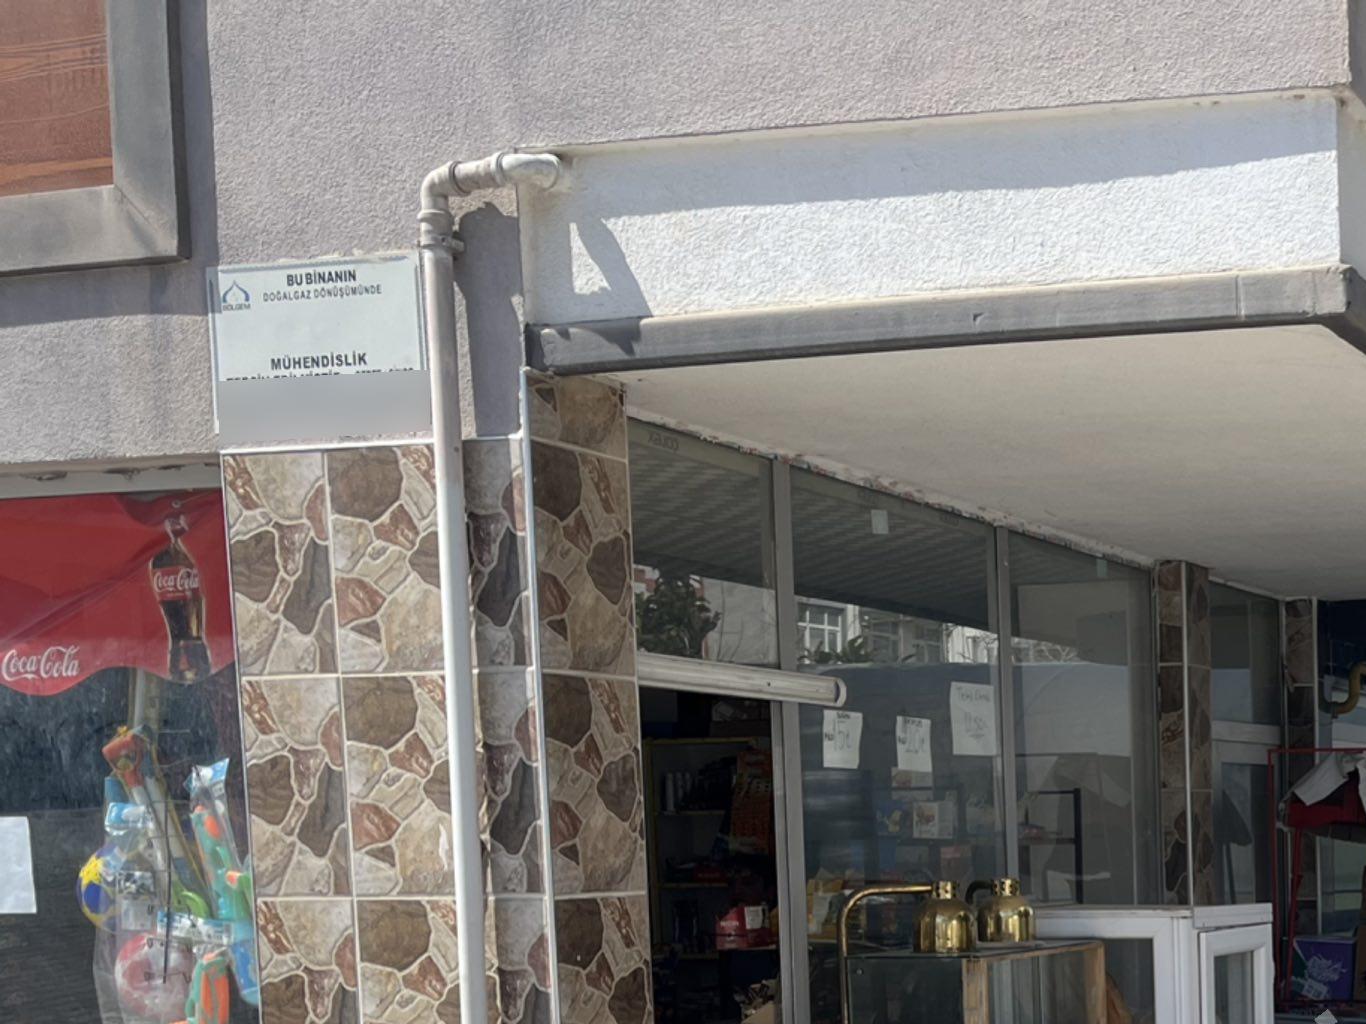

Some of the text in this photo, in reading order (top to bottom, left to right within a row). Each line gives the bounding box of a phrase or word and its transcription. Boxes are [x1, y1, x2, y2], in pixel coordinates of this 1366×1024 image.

[286, 269, 357, 287] BU BİNANIN
[263, 284, 382, 302] DOĞALGAZ DÖNÜŞÜMÜNDE
[270, 352, 368, 371] MÜHENDİSLİK
[1, 645, 80, 682] Coca-Cola
